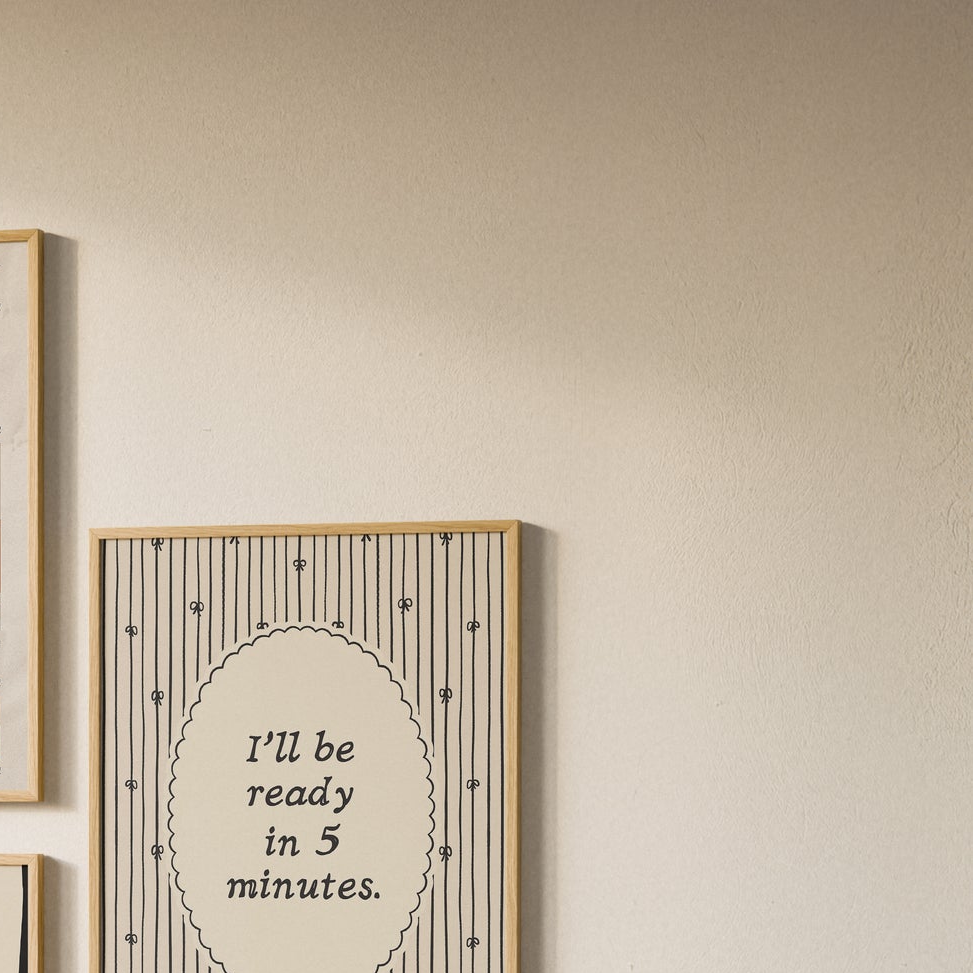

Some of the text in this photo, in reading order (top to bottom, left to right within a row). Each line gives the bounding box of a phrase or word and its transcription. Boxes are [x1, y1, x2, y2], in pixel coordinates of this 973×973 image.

[246, 730, 354, 763] I'll be
[247, 776, 354, 814] ready
[265, 823, 341, 856] in 5
[227, 869, 380, 900] minutes.
